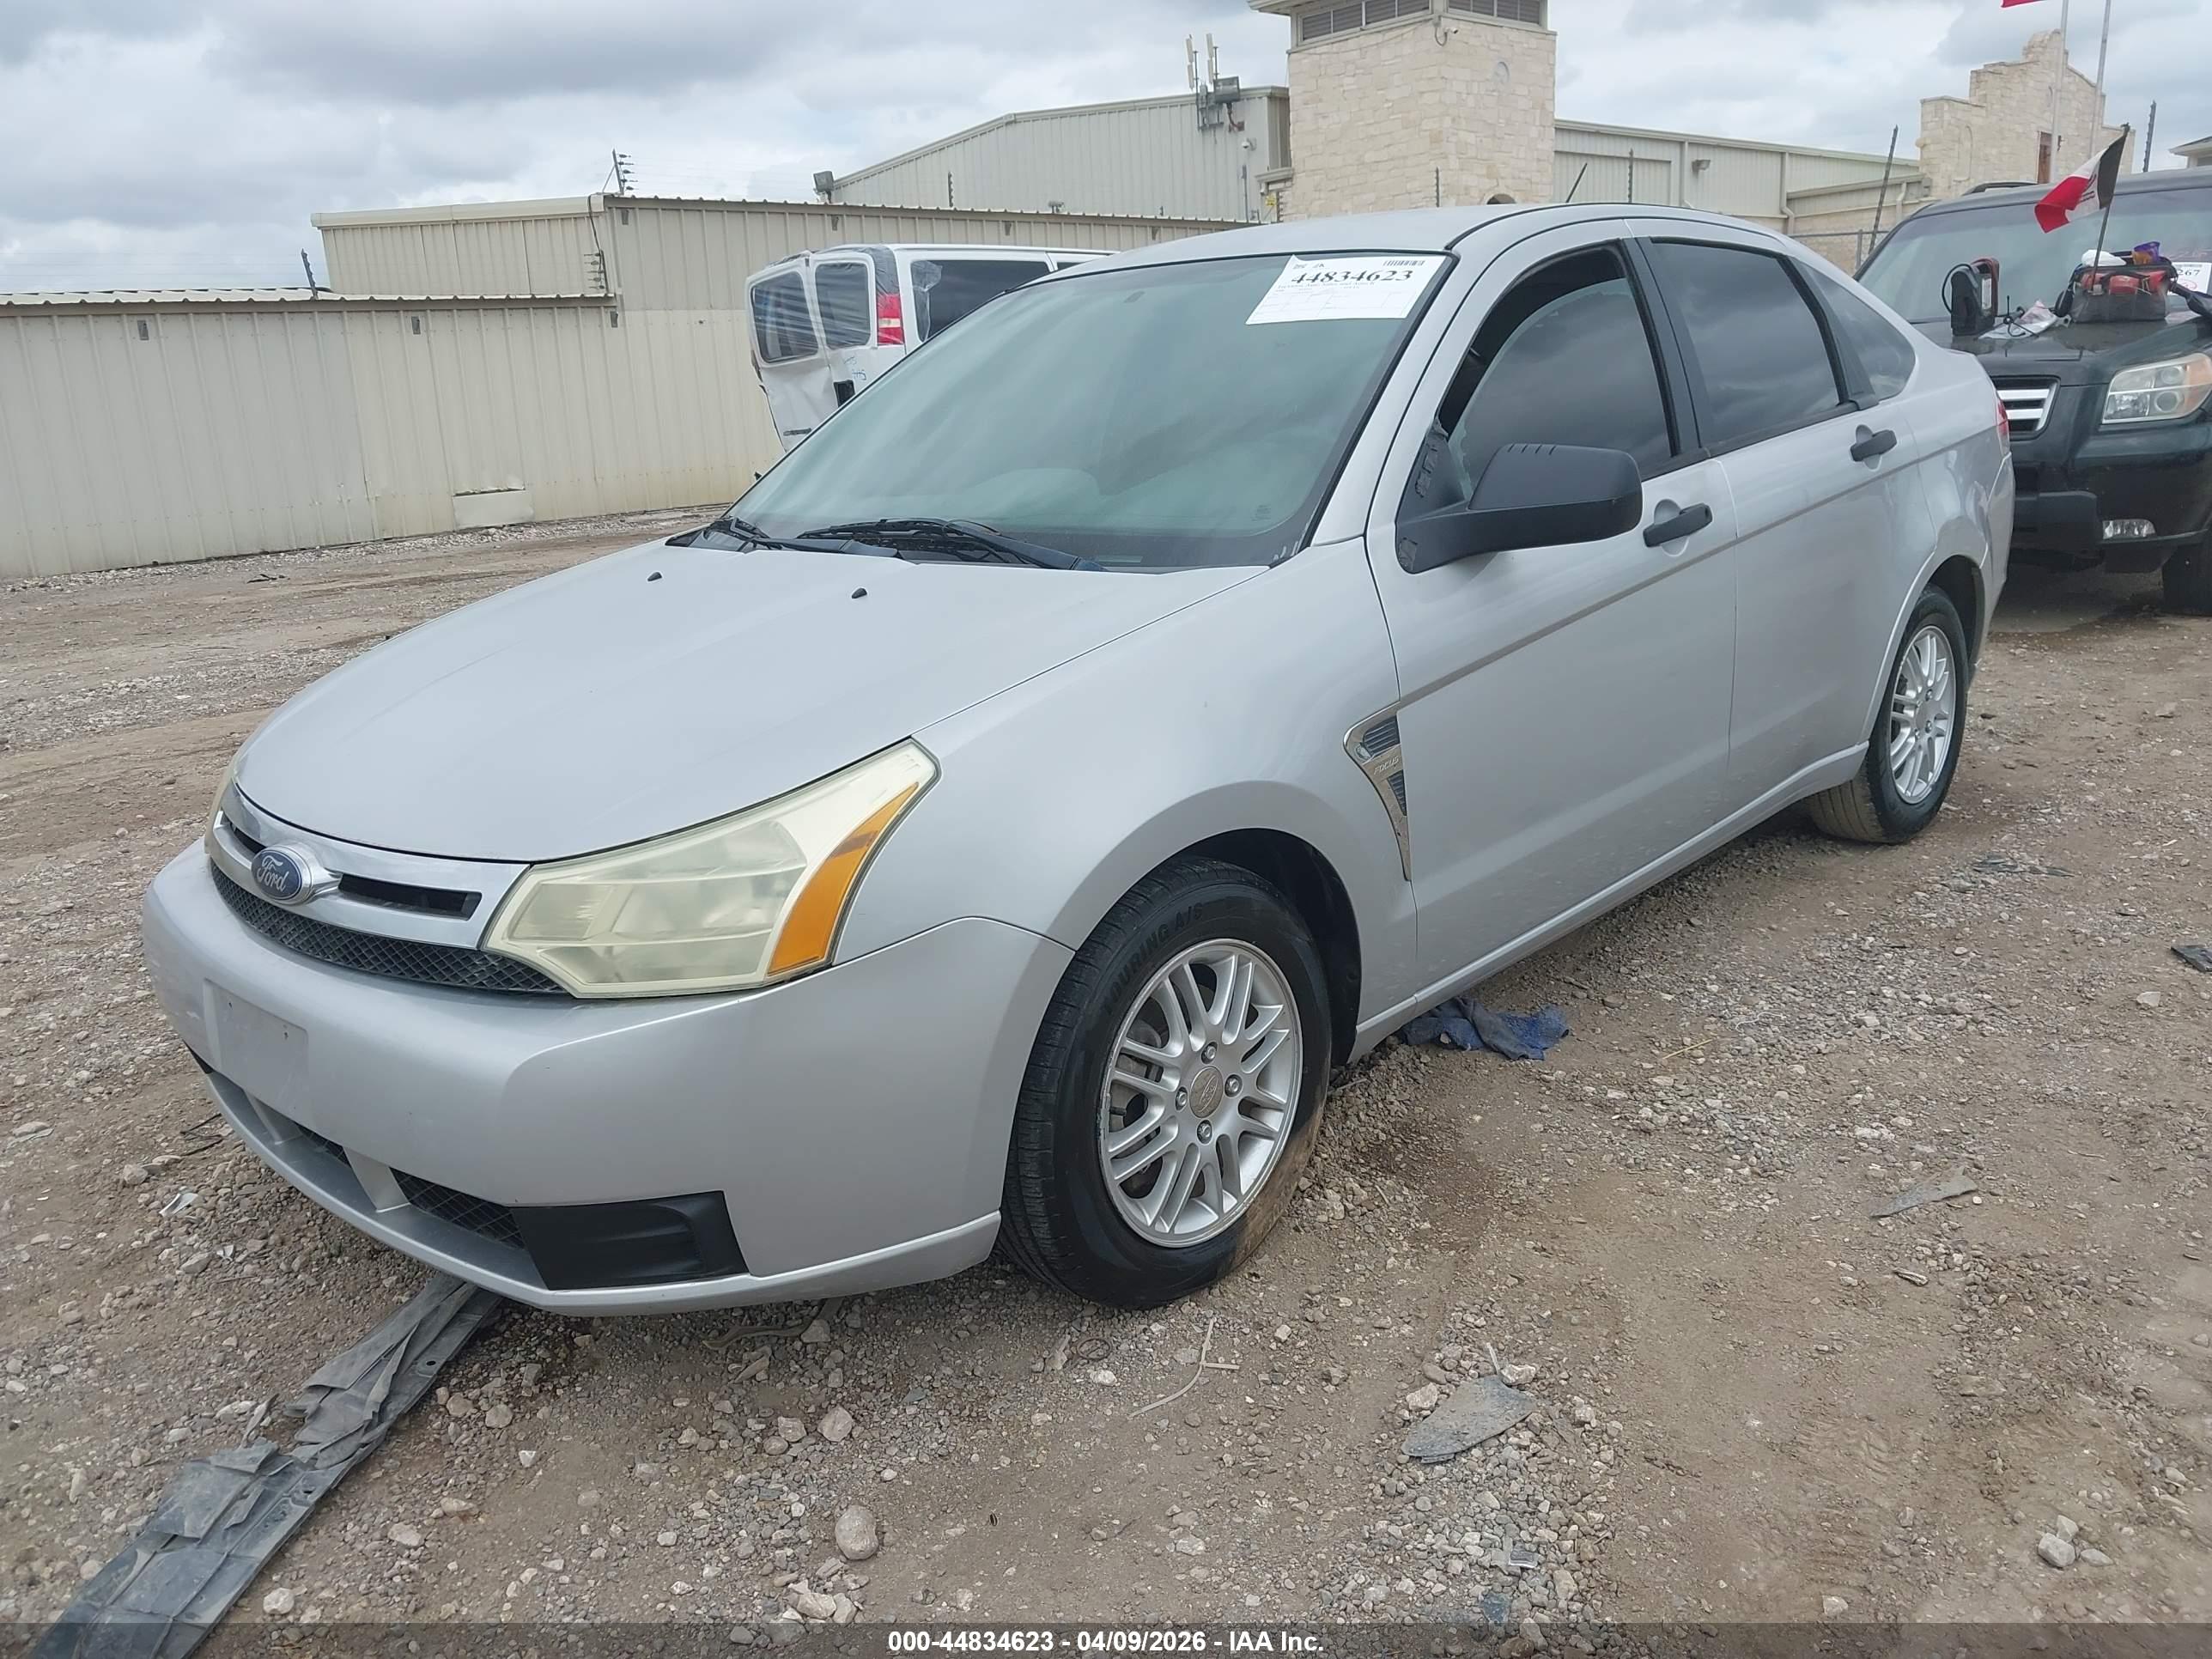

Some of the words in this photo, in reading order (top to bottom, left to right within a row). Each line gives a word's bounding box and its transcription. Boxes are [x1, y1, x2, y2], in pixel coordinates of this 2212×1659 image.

[1291, 270, 1413, 284] 44834623
[1374, 756, 1399, 775] FOCUS
[258, 856, 289, 892] Ford
